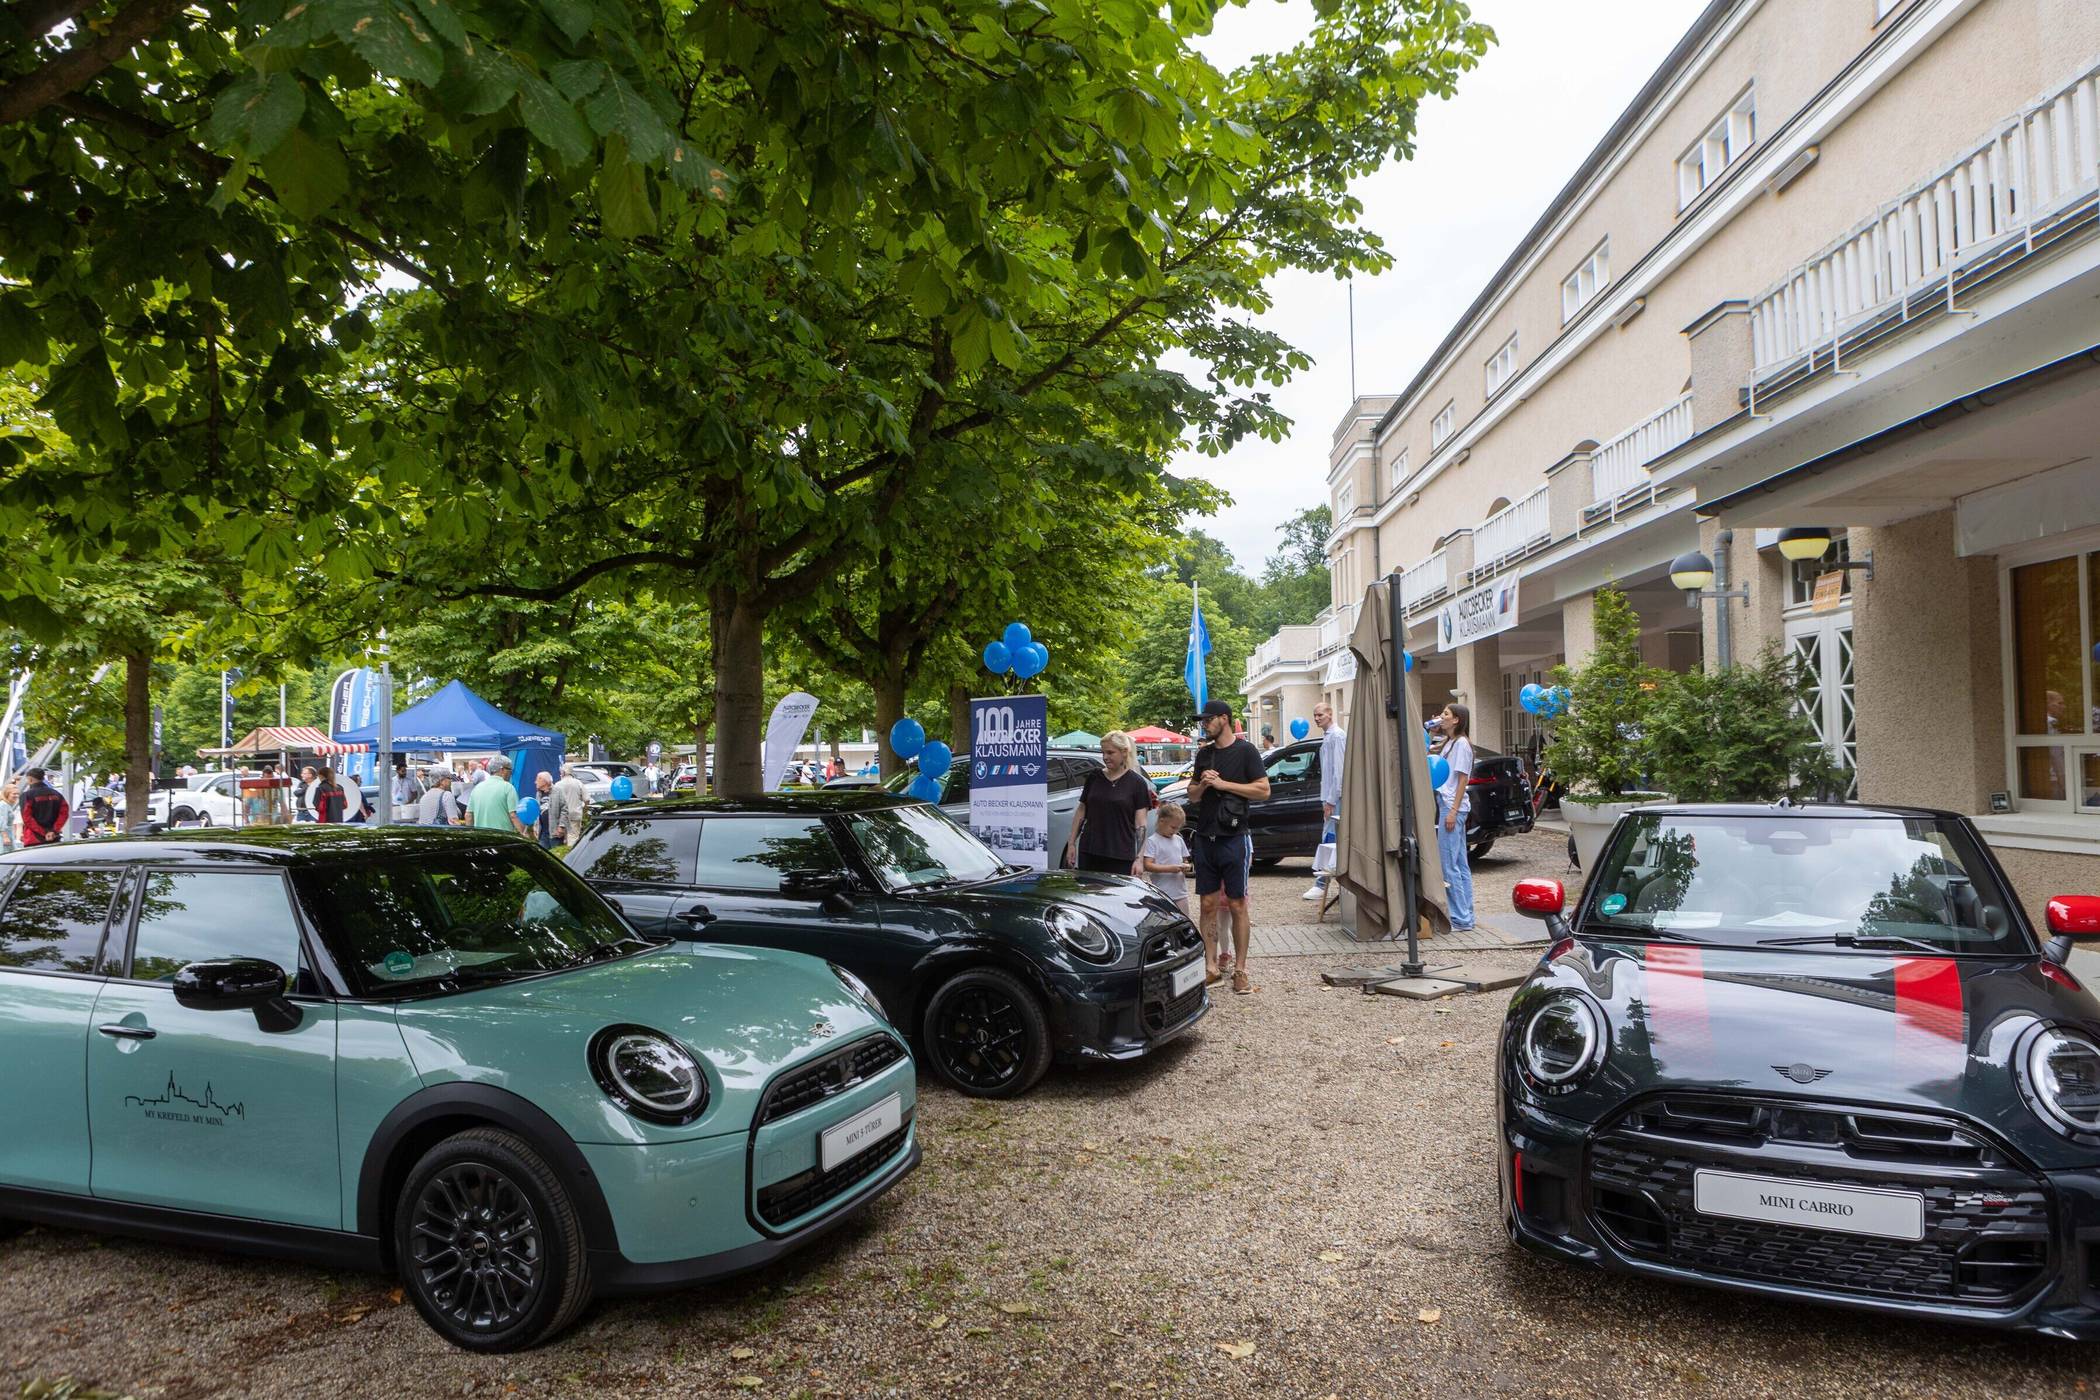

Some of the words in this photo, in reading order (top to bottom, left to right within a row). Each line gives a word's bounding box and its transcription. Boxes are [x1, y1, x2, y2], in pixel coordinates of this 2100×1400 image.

[1016, 719, 1042, 729] JAHRE
[975, 743, 1042, 758] KLAUSMANN
[145, 1109, 156, 1119] MY
[193, 1115, 204, 1124] MY
[1759, 1193, 1795, 1210] MINI
[1798, 1199, 1854, 1217] CABRIO
